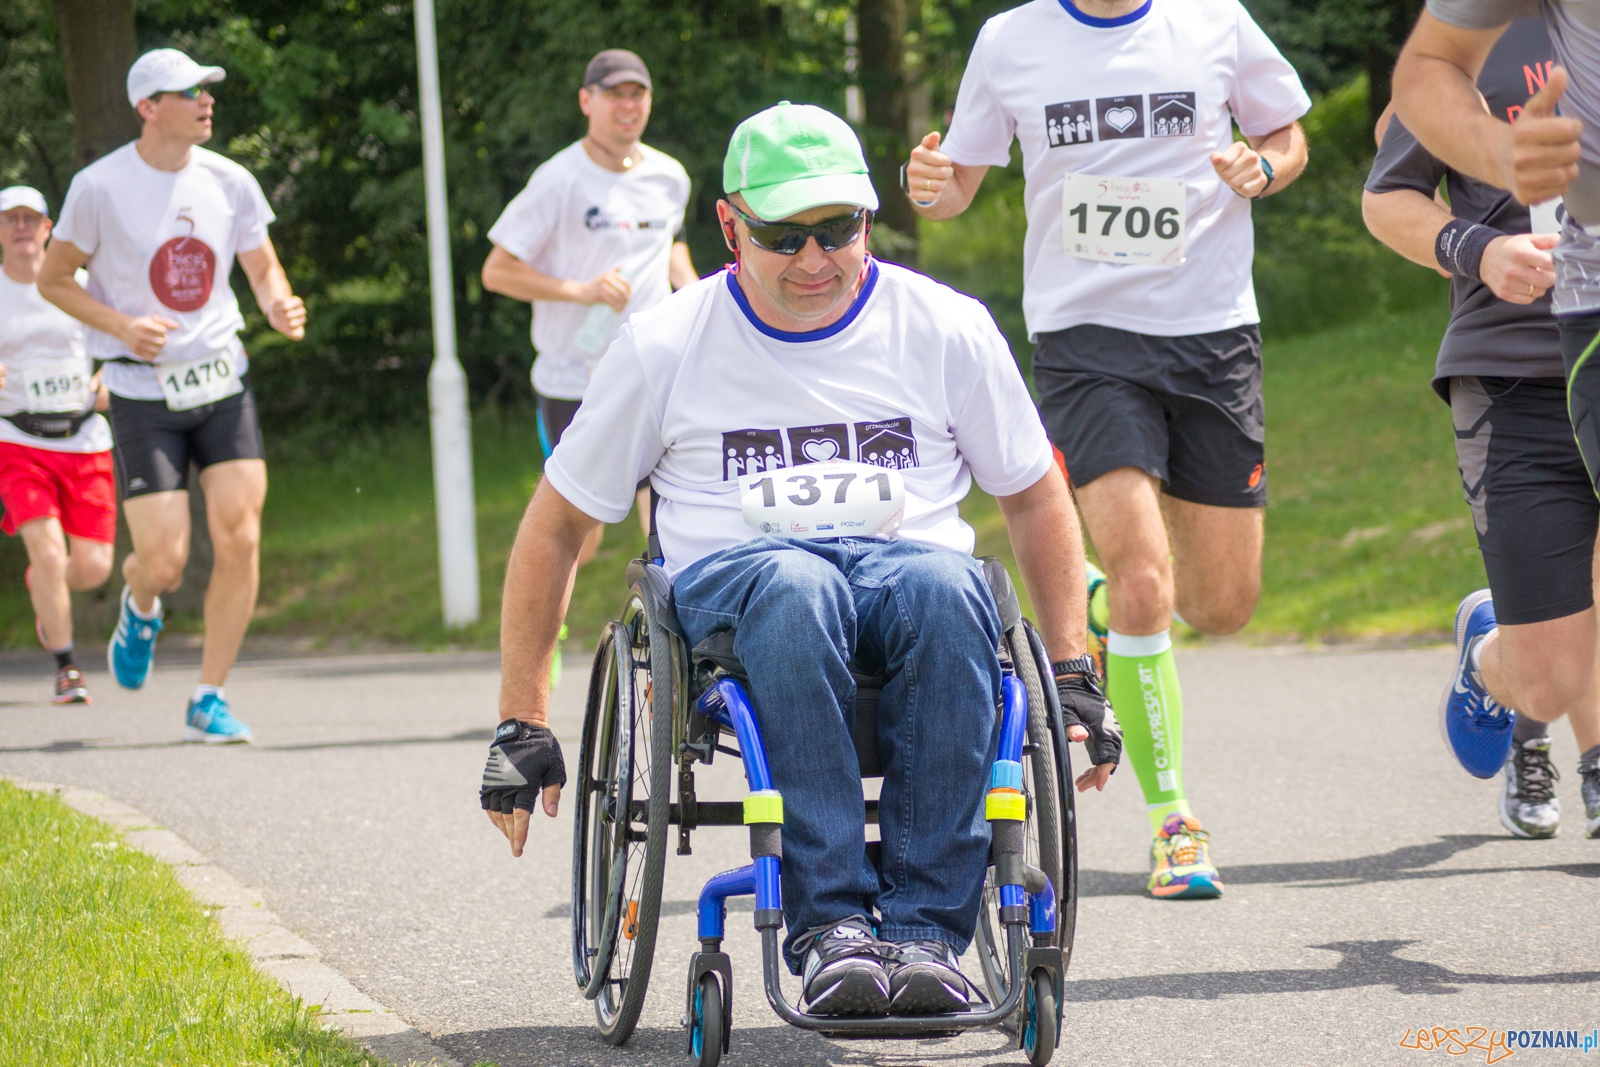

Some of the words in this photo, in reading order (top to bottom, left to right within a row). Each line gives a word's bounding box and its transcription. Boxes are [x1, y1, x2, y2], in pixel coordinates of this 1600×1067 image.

[1522, 60, 1553, 95] N
[1069, 202, 1180, 240] 1706
[30, 373, 83, 397] 1595
[166, 359, 230, 393] 1470
[748, 472, 892, 508] 1371
